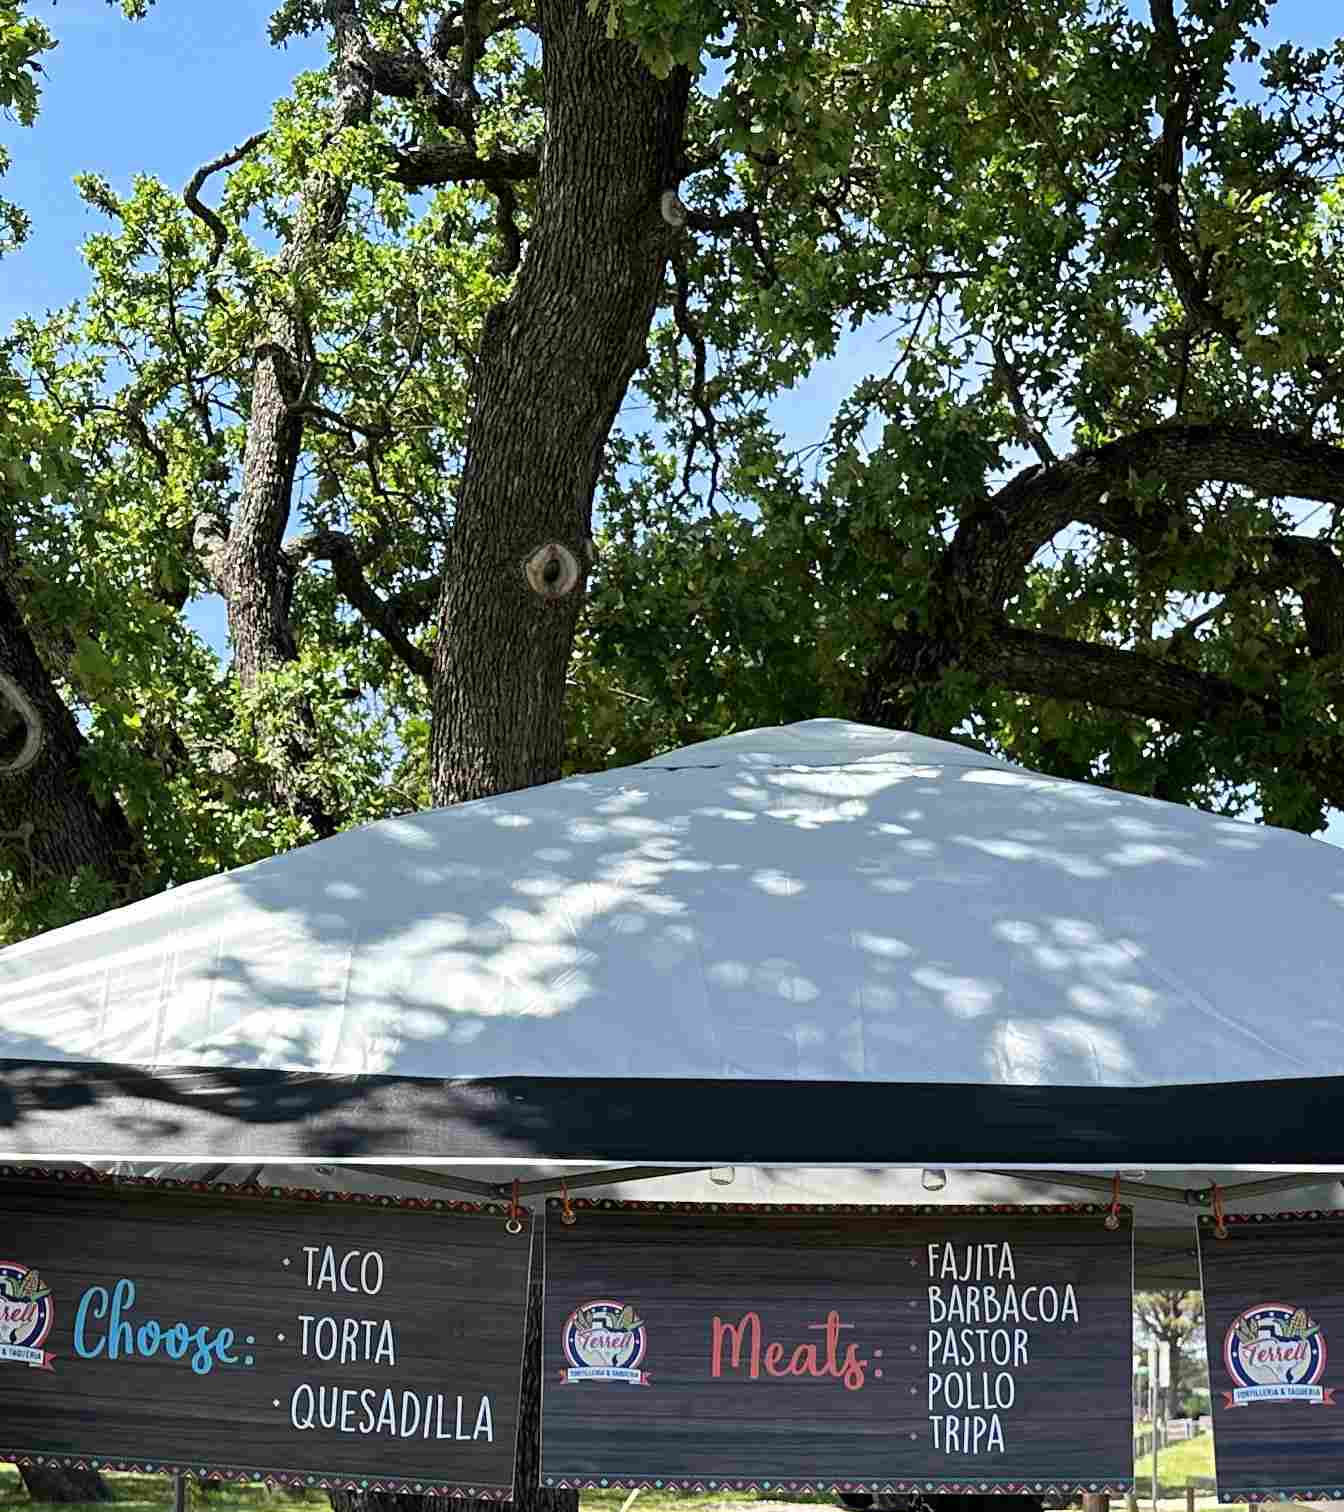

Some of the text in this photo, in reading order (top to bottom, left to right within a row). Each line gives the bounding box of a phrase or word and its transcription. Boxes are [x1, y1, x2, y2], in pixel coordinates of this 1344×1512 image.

[302, 1245, 385, 1295] TACO
[927, 1242, 1017, 1282] FAJITA
[927, 1284, 1080, 1325] BARBACOA
[73, 1279, 256, 1376] Choose:
[297, 1314, 398, 1367] TORTA
[927, 1329, 1029, 1368] PASTOR
[711, 1310, 884, 1391] Meats:
[290, 1383, 495, 1443] QUESADILLA
[928, 1372, 1016, 1411] POLLO
[929, 1415, 1006, 1456] TRIPA
